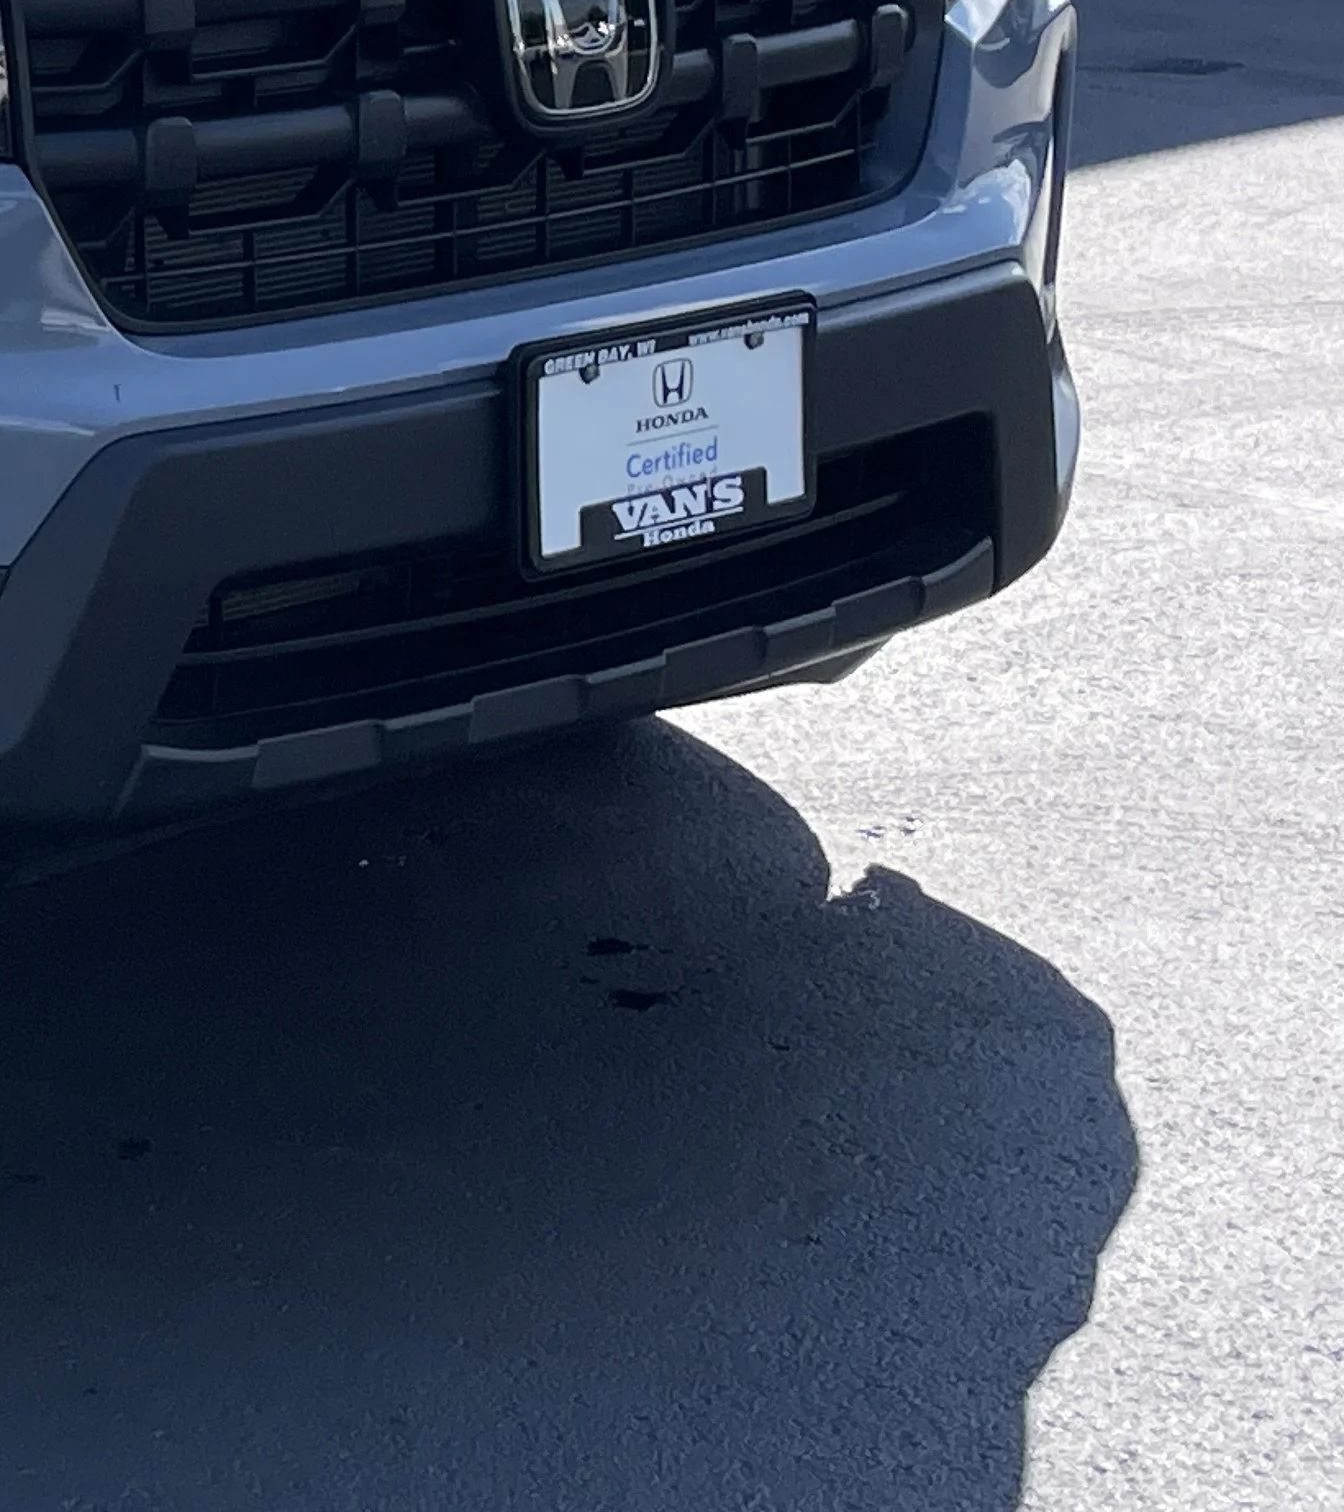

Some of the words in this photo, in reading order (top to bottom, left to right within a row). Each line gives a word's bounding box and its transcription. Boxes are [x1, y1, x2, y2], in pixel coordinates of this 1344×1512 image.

[544, 352, 596, 375] GREEN
[637, 338, 656, 358] WI
[635, 407, 709, 433] HONDA
[626, 436, 718, 478] Certified
[643, 520, 715, 547] Honda
